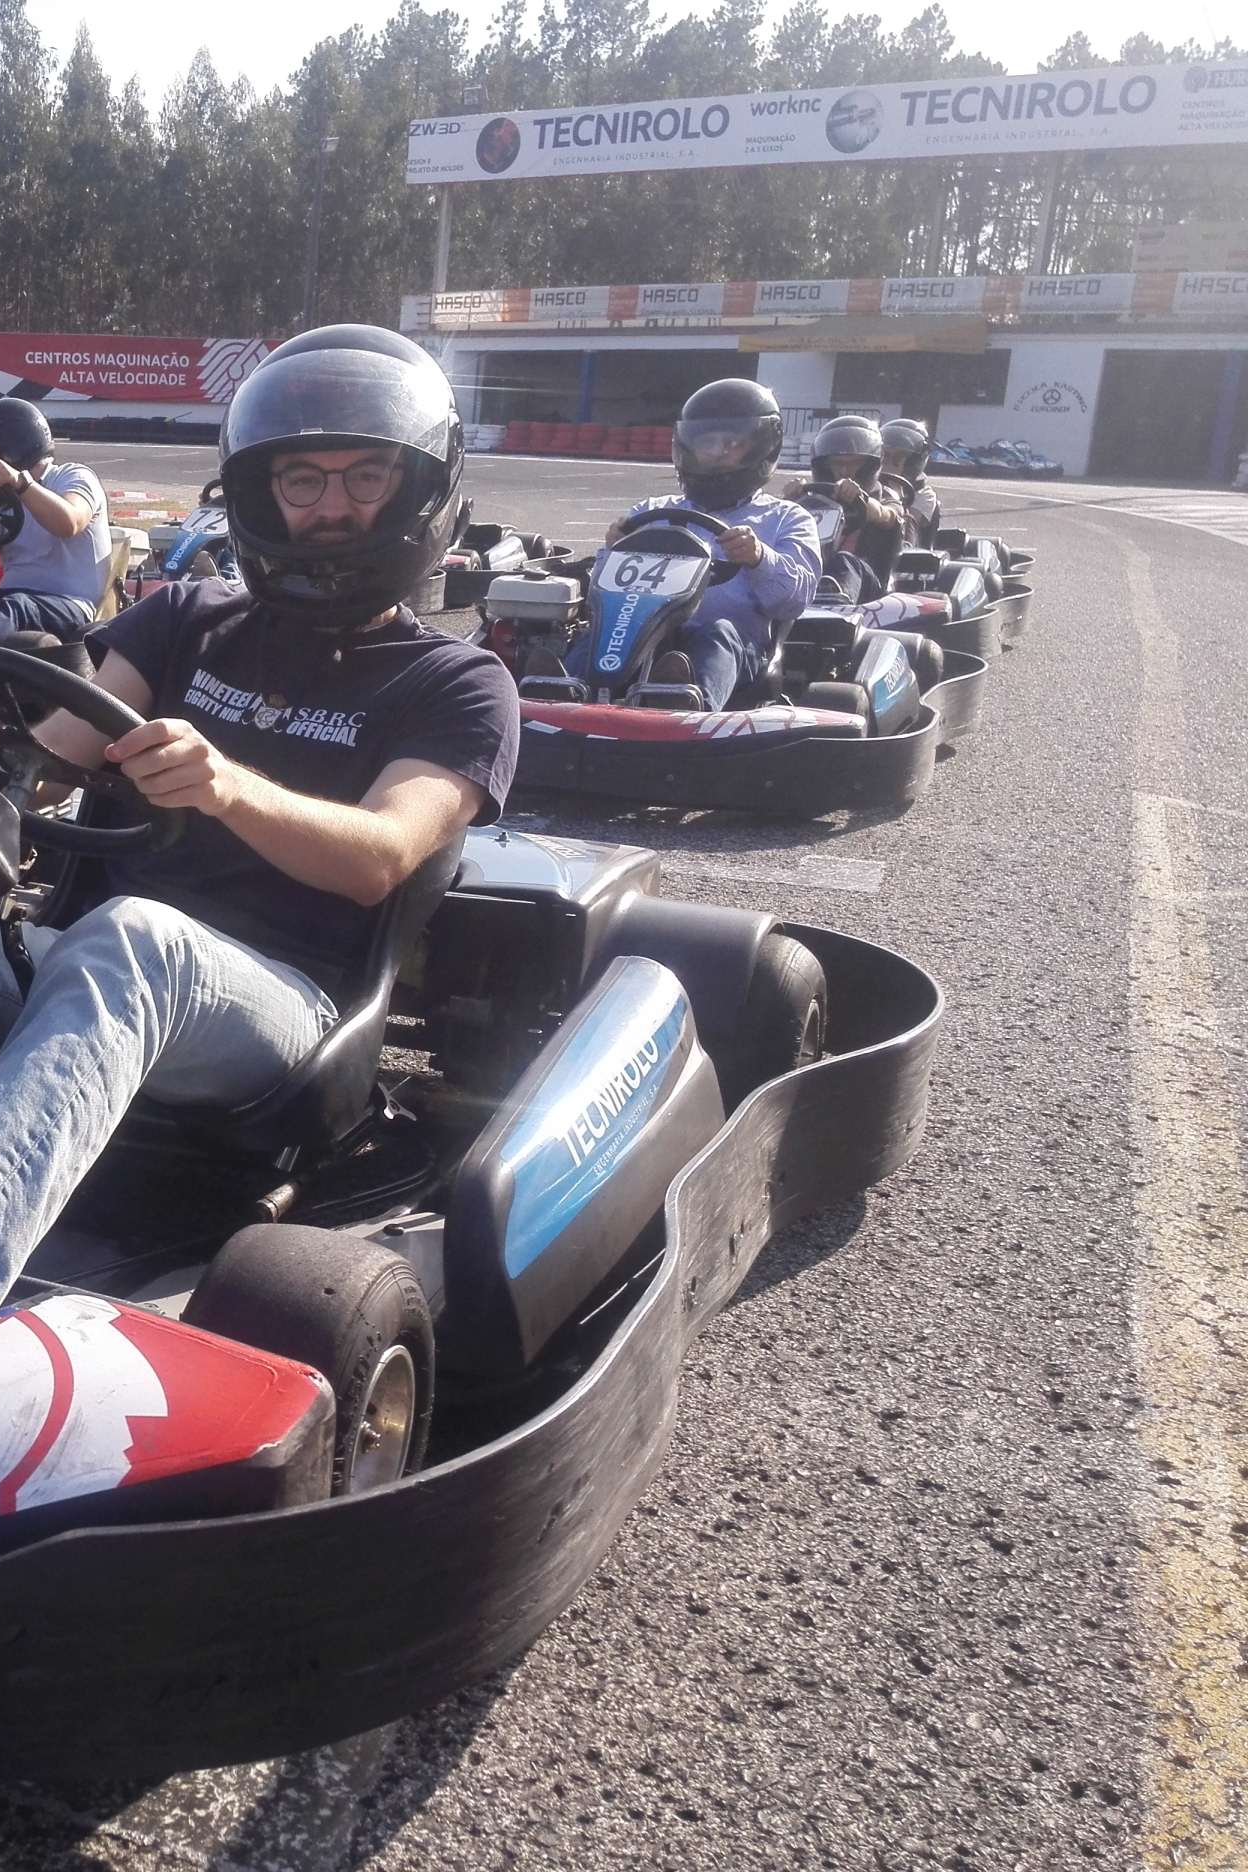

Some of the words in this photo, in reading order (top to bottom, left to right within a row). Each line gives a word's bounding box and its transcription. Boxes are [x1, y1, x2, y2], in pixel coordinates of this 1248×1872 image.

[750, 94, 822, 117] worknc
[900, 74, 1157, 127] TECNIROLO
[533, 104, 730, 149] TECNIROLO
[643, 288, 699, 303] HASCO
[760, 285, 821, 300] HASCO
[888, 282, 955, 299] HASCO
[1028, 278, 1102, 296] HASCO
[435, 295, 482, 310] HASCO
[534, 291, 587, 307] HASCO
[25, 351, 91, 365] CENTROS
[94, 352, 190, 370] MAQUINAÇÃO
[58, 370, 95, 384] ALTA
[98, 372, 187, 386] VELOCIDADE
[190, 510, 227, 531] 72
[614, 555, 672, 589] 64
[606, 593, 640, 654] TECNIROLO
[183, 688, 221, 717] EIGHTY
[286, 720, 357, 747] OFFICIAL
[556, 1036, 660, 1169] TECNIROLO
